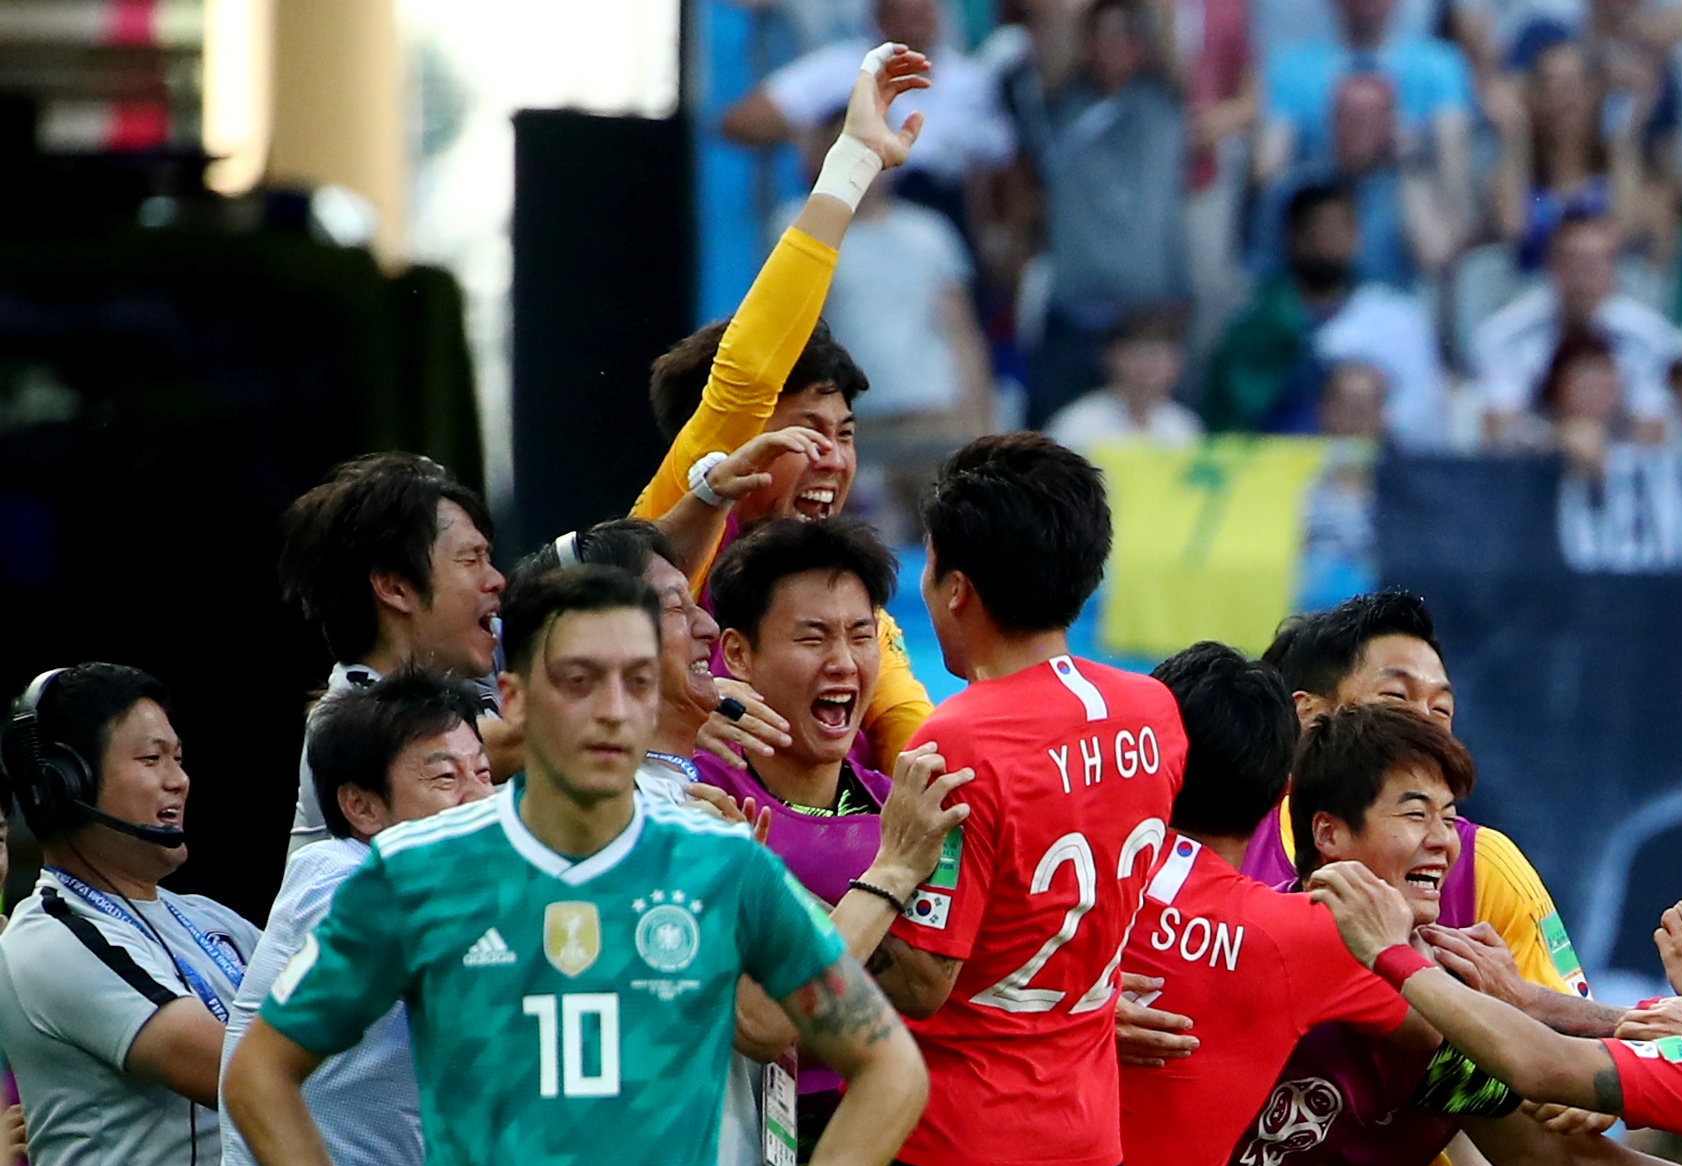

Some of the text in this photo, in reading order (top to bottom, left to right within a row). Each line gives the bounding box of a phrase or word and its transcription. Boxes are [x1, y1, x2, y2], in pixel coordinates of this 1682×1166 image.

[1048, 726, 1160, 794] Y H GO
[87, 889, 123, 920] WORLD
[968, 817, 1167, 1014] 22
[1151, 906, 1244, 972] SON
[523, 992, 621, 1098] 10
